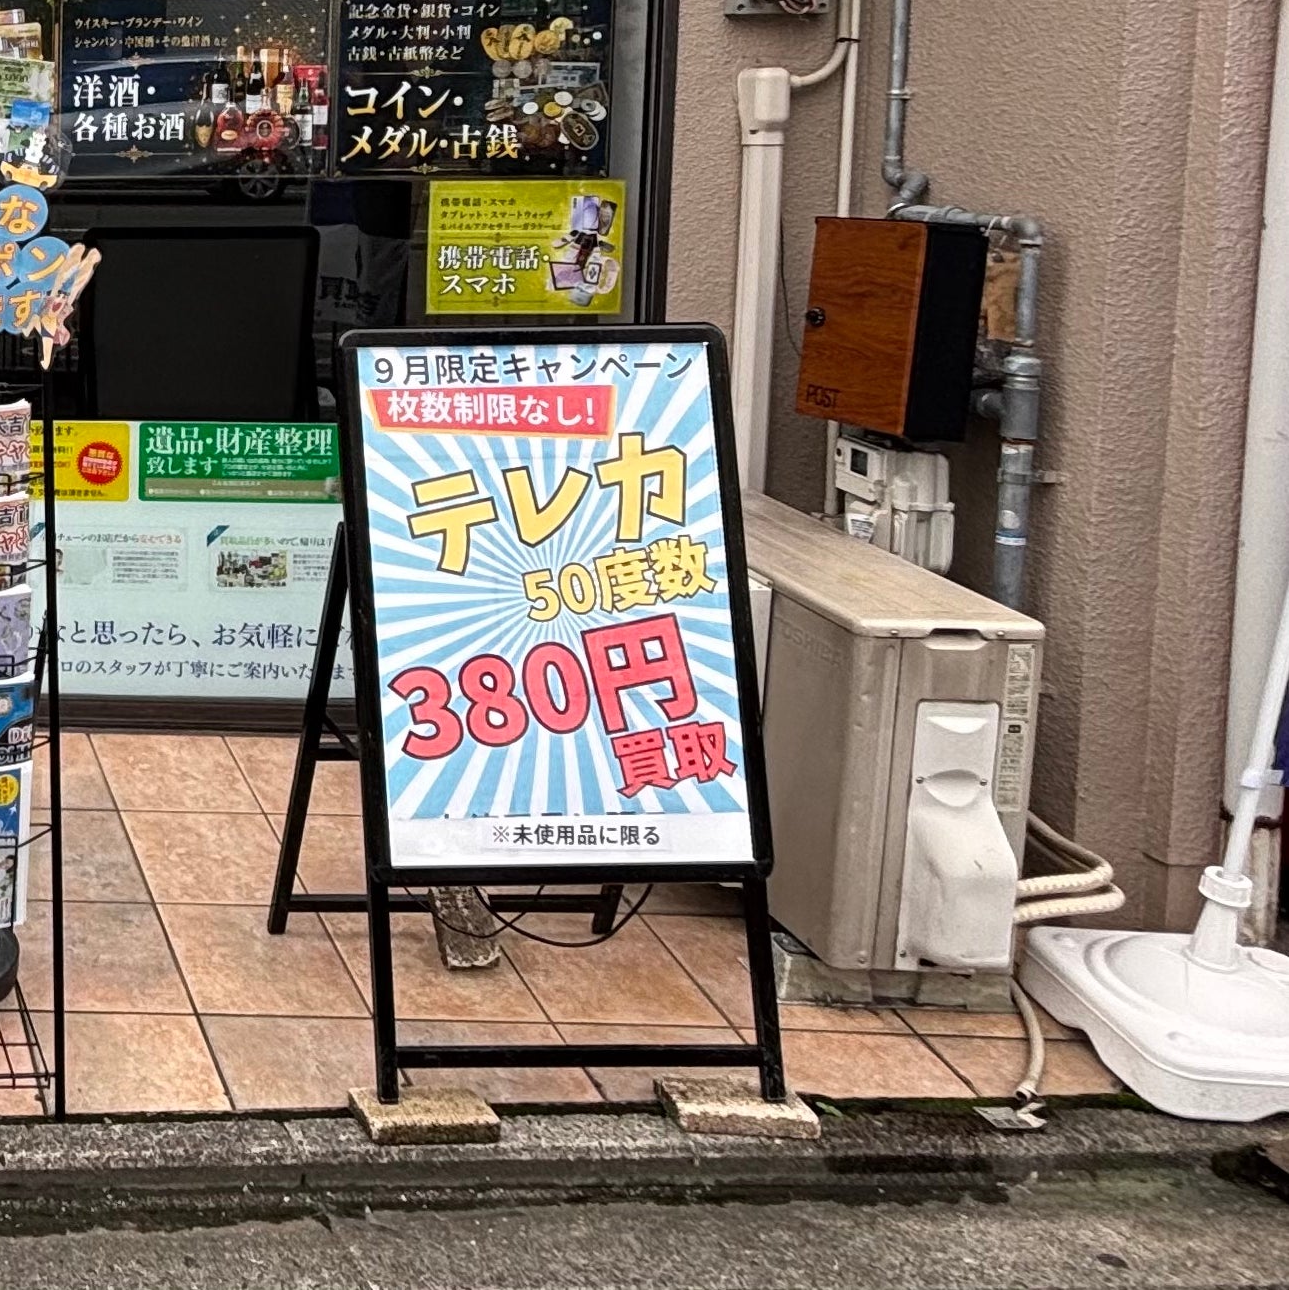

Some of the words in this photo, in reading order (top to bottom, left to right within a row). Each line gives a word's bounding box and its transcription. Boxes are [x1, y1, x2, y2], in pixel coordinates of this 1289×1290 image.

[347, 3, 501, 19] 記念金貨・銀貨・コイン
[347, 24, 472, 41] メダル・大判・小判
[346, 45, 465, 62] 古銭・古紙幣など
[72, 112, 187, 143] 各種お酒
[340, 123, 521, 161] メダル・古銭
[440, 273, 516, 295] スマホ
[374, 352, 693, 385] 9月限定キャンペーン
[387, 390, 596, 426] 枚数制限なし!
[806, 384, 841, 408] POST
[145, 425, 333, 456] 遺品・財産整理
[146, 456, 219, 476] 致します
[406, 430, 686, 576] テレカ
[521, 534, 718, 623] 50度数
[387, 613, 701, 760] 380円
[610, 721, 738, 799] 買取
[492, 823, 661, 848] ※未使用品に限る
